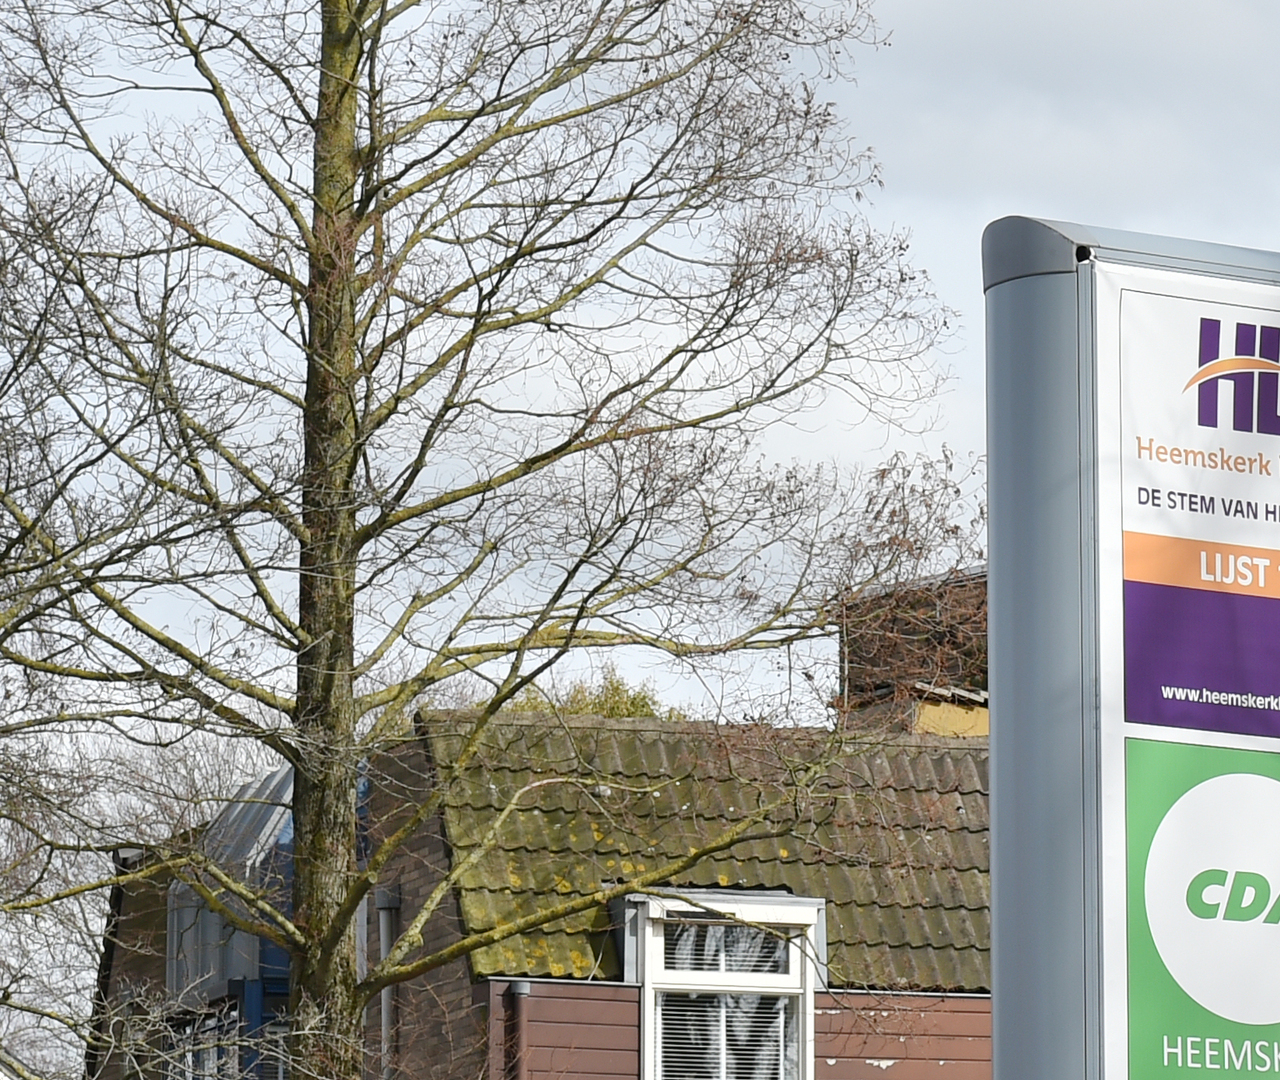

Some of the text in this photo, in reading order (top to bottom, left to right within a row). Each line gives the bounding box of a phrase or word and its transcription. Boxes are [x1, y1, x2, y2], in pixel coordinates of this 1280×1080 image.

[1135, 437, 1271, 476] Heemskerk
[1137, 488, 1162, 510] DE
[1167, 491, 1215, 516] STEM
[1220, 497, 1259, 519] VAN
[1199, 551, 1271, 589] LIJST
